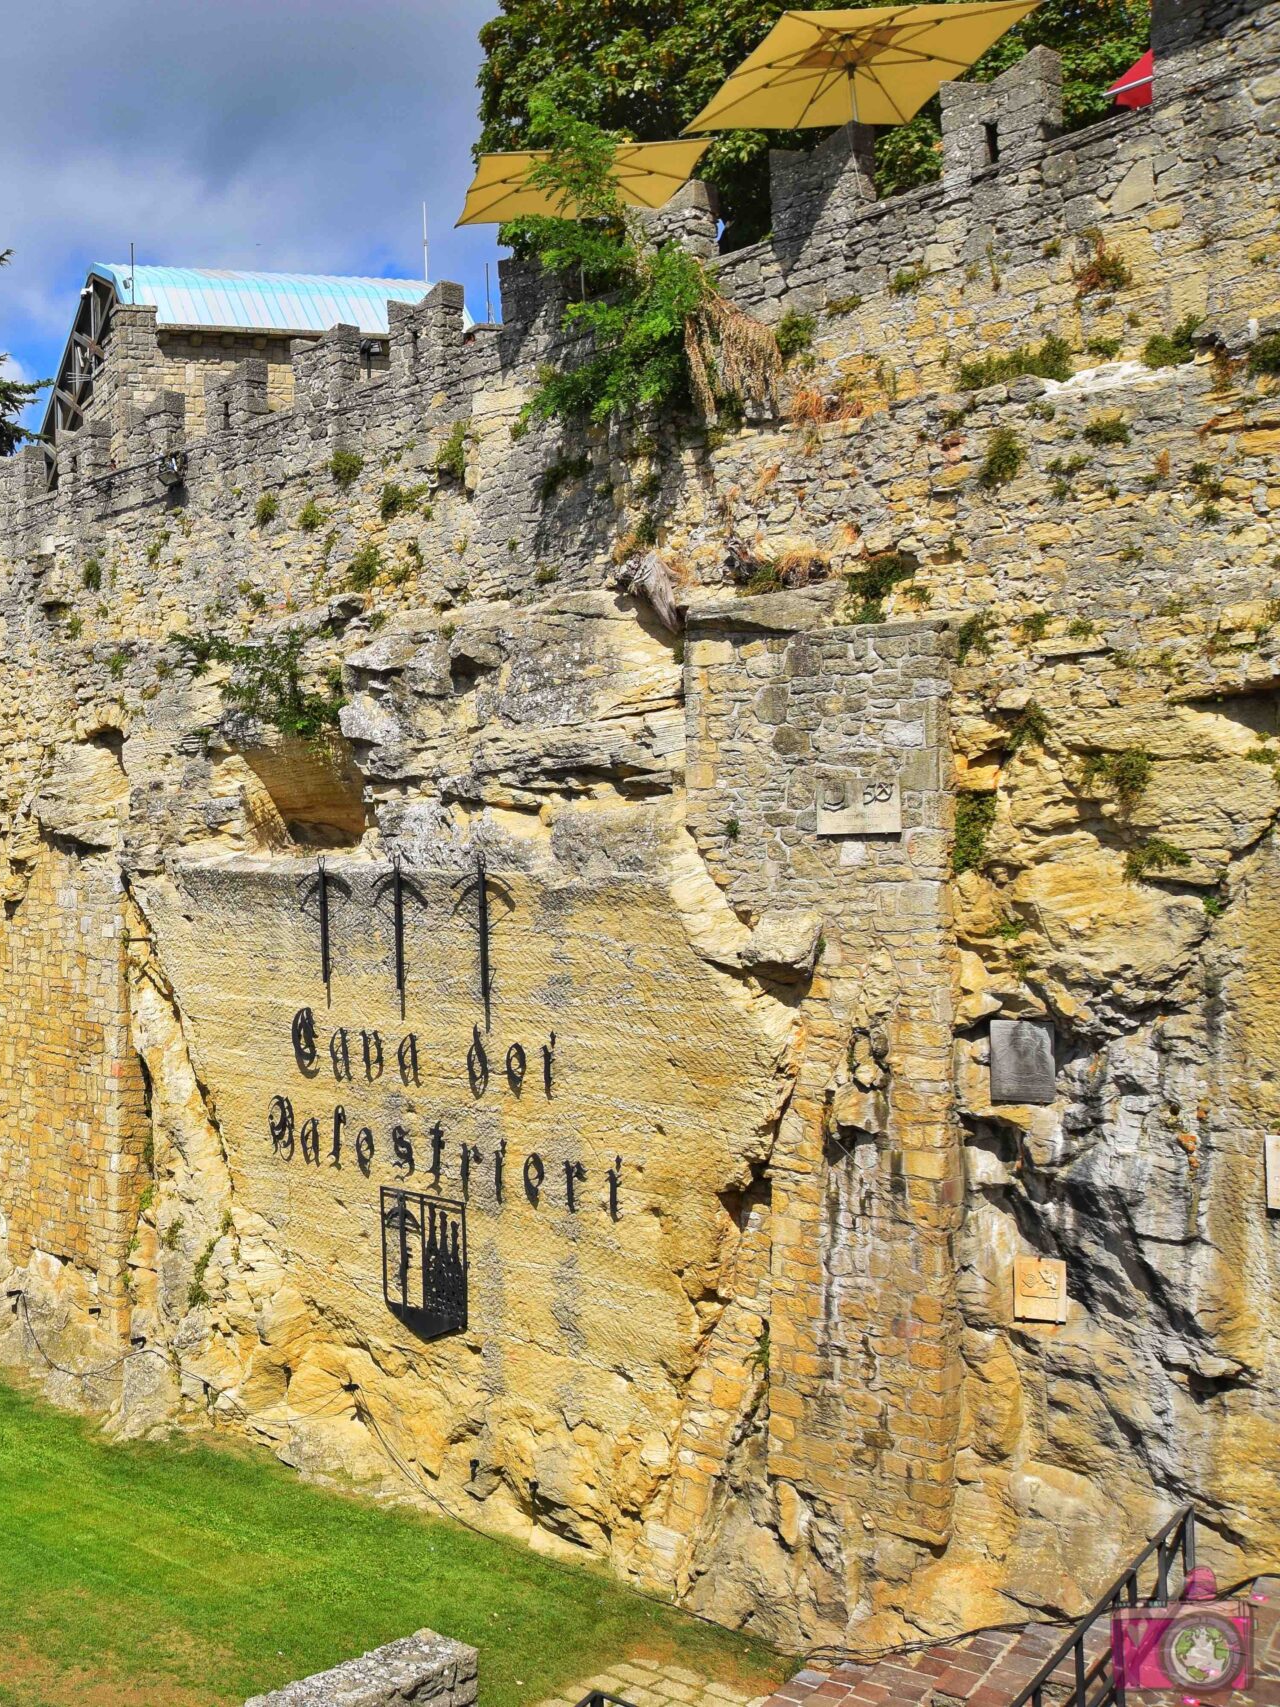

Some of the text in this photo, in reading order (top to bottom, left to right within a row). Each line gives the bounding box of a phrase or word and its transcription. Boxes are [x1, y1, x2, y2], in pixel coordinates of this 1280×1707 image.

[291, 1006, 557, 1100] Cava dei
[267, 1094, 622, 1222] Balestrieri
